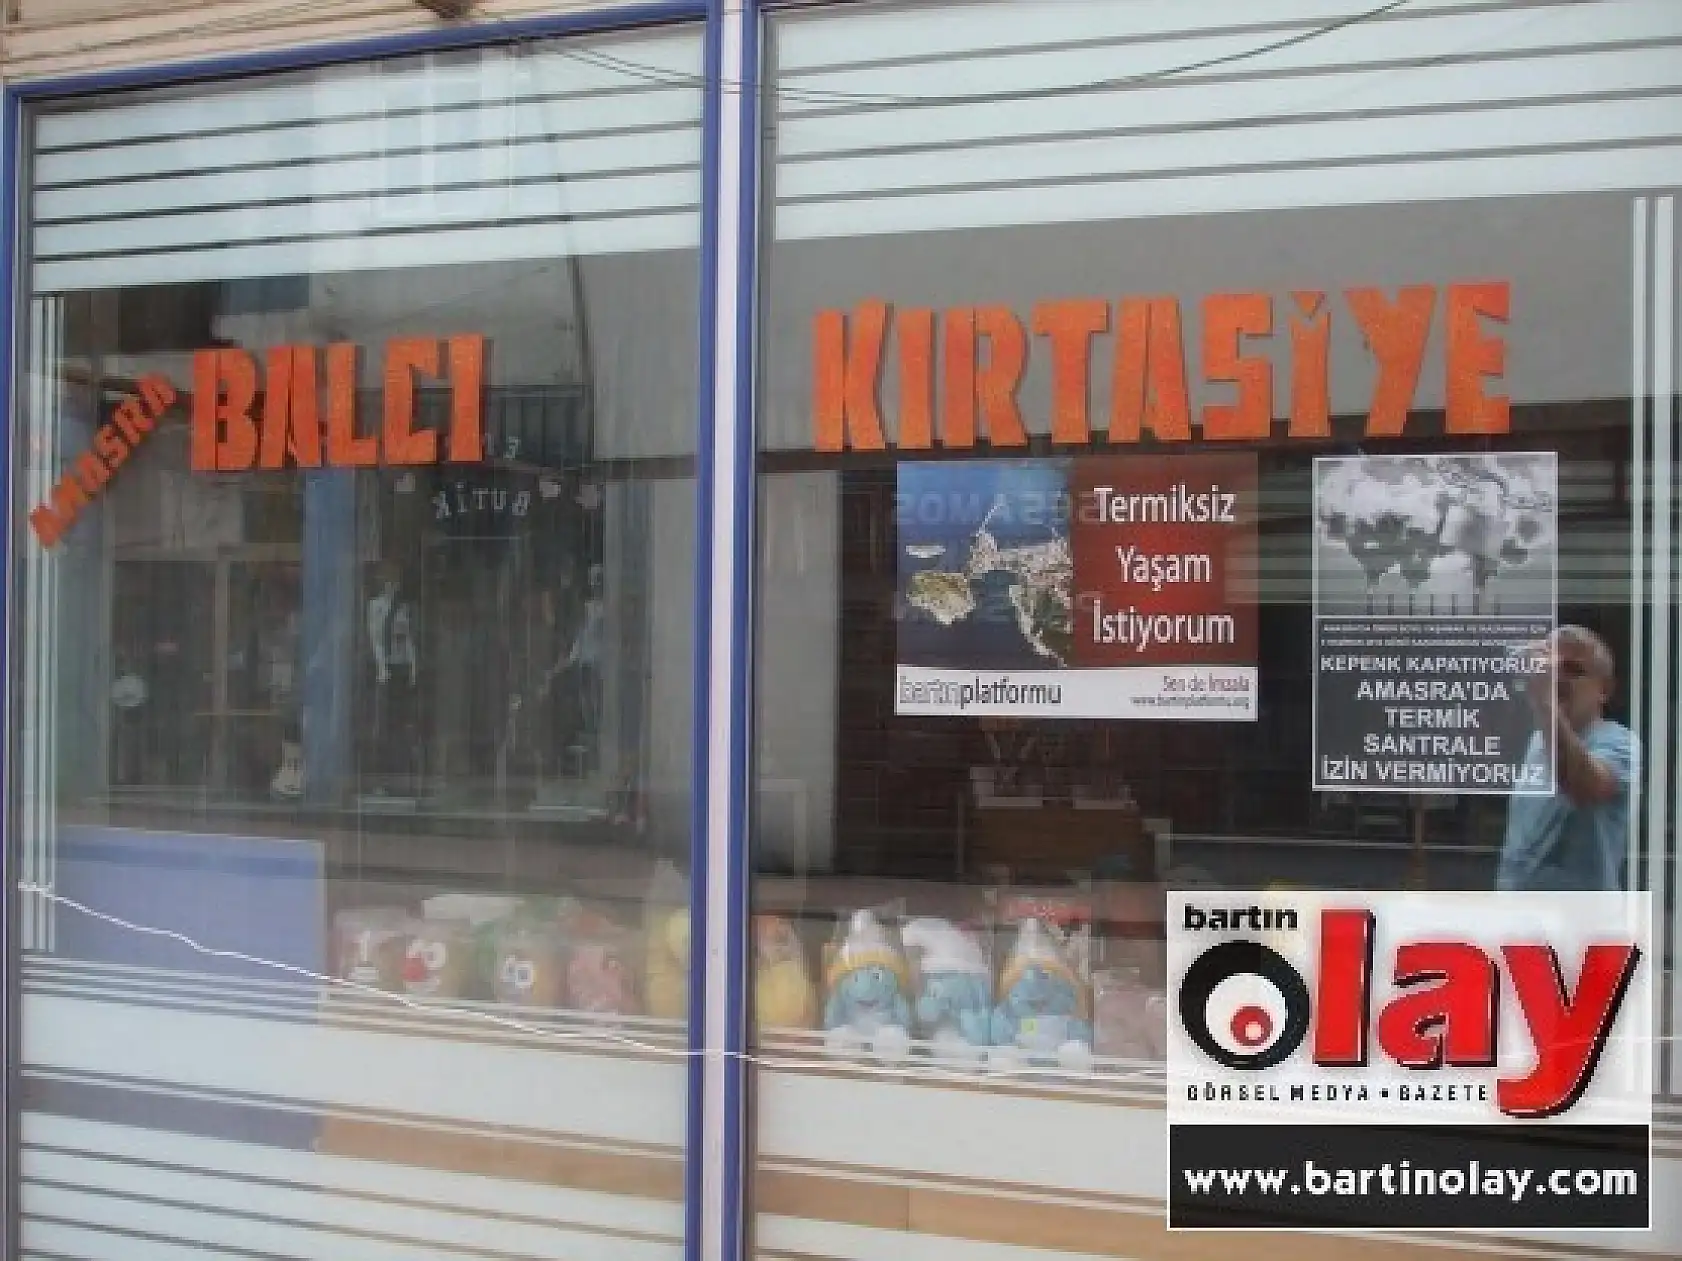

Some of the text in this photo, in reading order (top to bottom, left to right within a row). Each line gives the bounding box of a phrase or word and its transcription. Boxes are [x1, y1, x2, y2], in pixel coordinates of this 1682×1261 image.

[813, 282, 1511, 452] KIRTASİYE
[191, 333, 485, 471] BALCI
[1093, 482, 1237, 523] Termiksiz
[1115, 545, 1211, 592] Yaşam
[1093, 600, 1235, 652] İstiyorum
[1321, 655, 1547, 674] KEPENK KAPATIYORUZ
[1357, 679, 1510, 701] AMASRA'DA
[1385, 703, 1480, 729] TERMİK
[1363, 733, 1501, 756] SANTRALE
[1321, 755, 1544, 783] İZİN VERMİYORUZ
